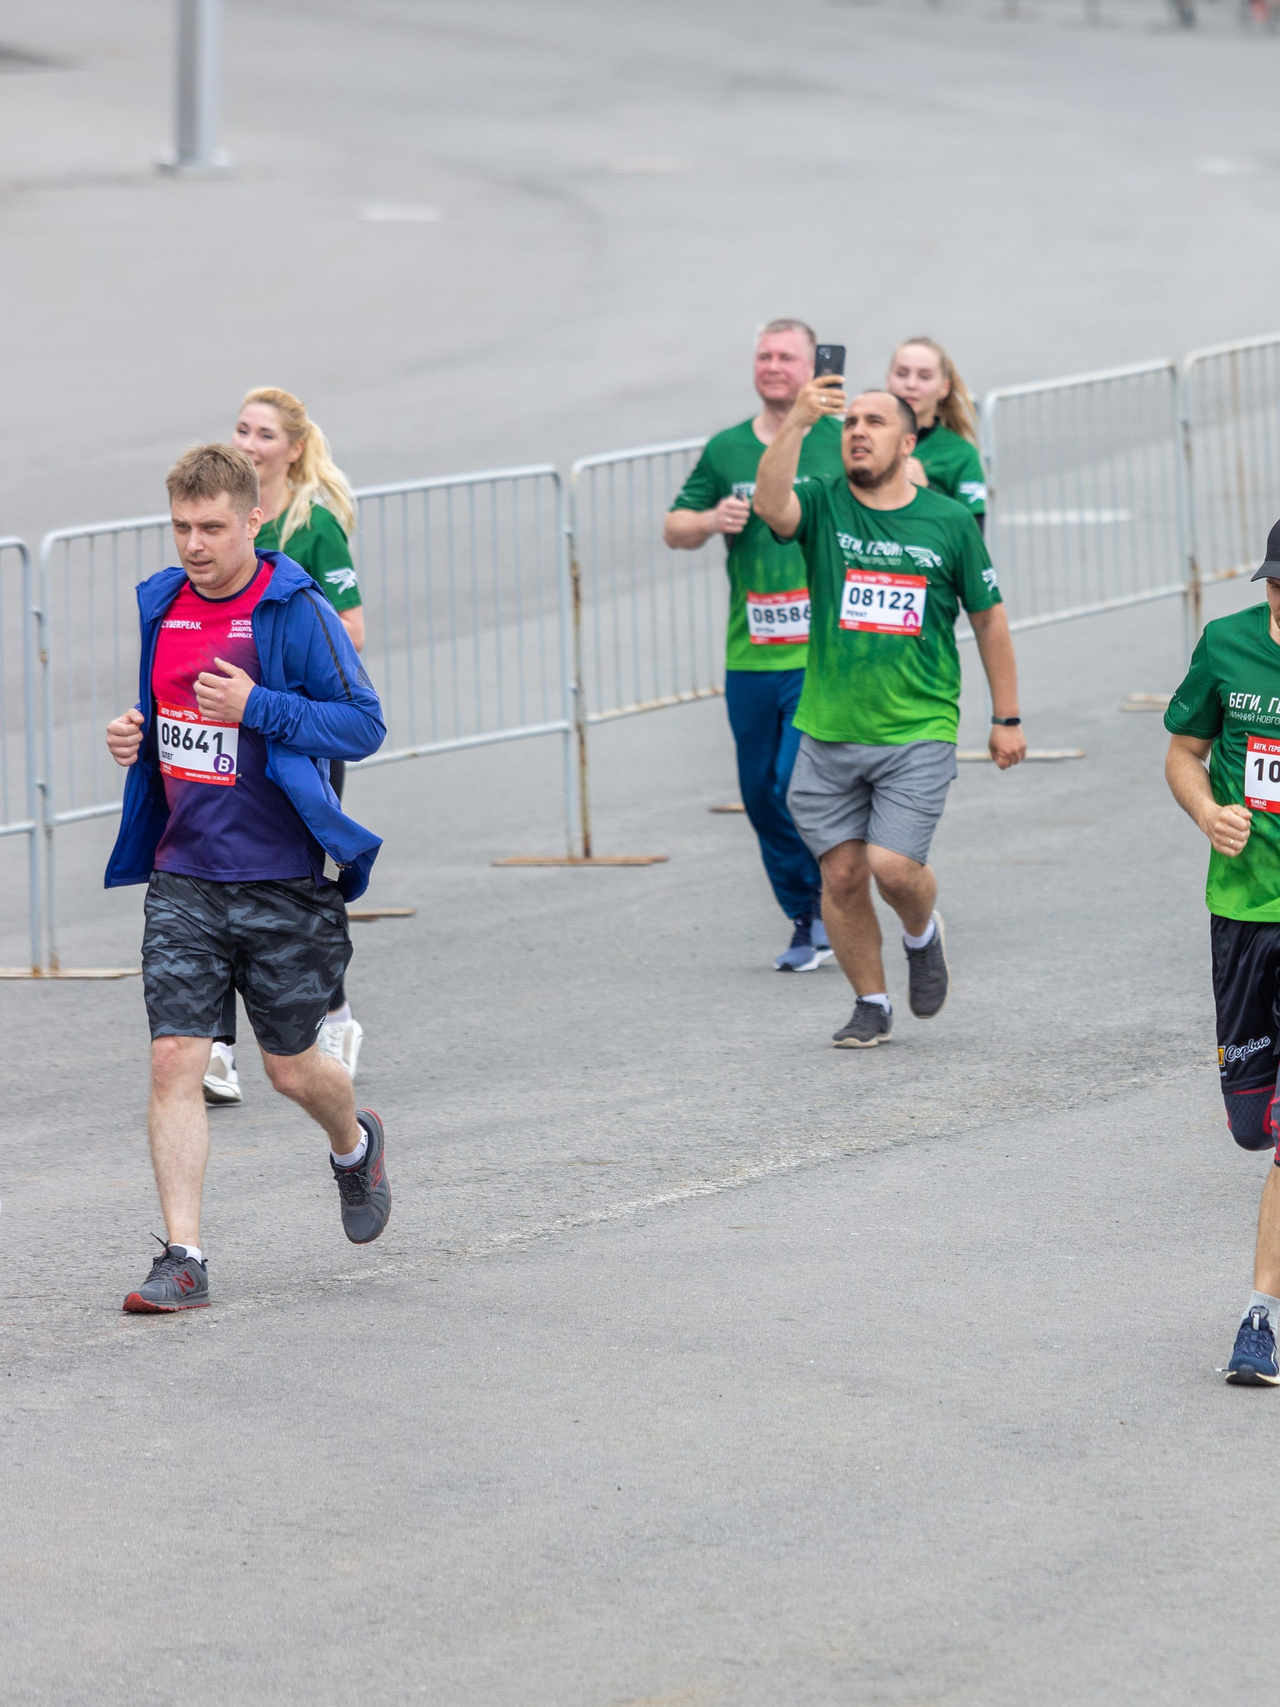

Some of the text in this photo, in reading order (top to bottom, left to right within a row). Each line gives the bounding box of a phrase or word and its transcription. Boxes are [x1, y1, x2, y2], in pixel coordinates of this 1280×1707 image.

[848, 586, 916, 612] 08122
[1229, 692, 1262, 714] БЕГИ,
[161, 722, 224, 755] 08641
[1253, 742, 1267, 752] БЕГИ,
[1225, 1035, 1271, 1063] Сервис
